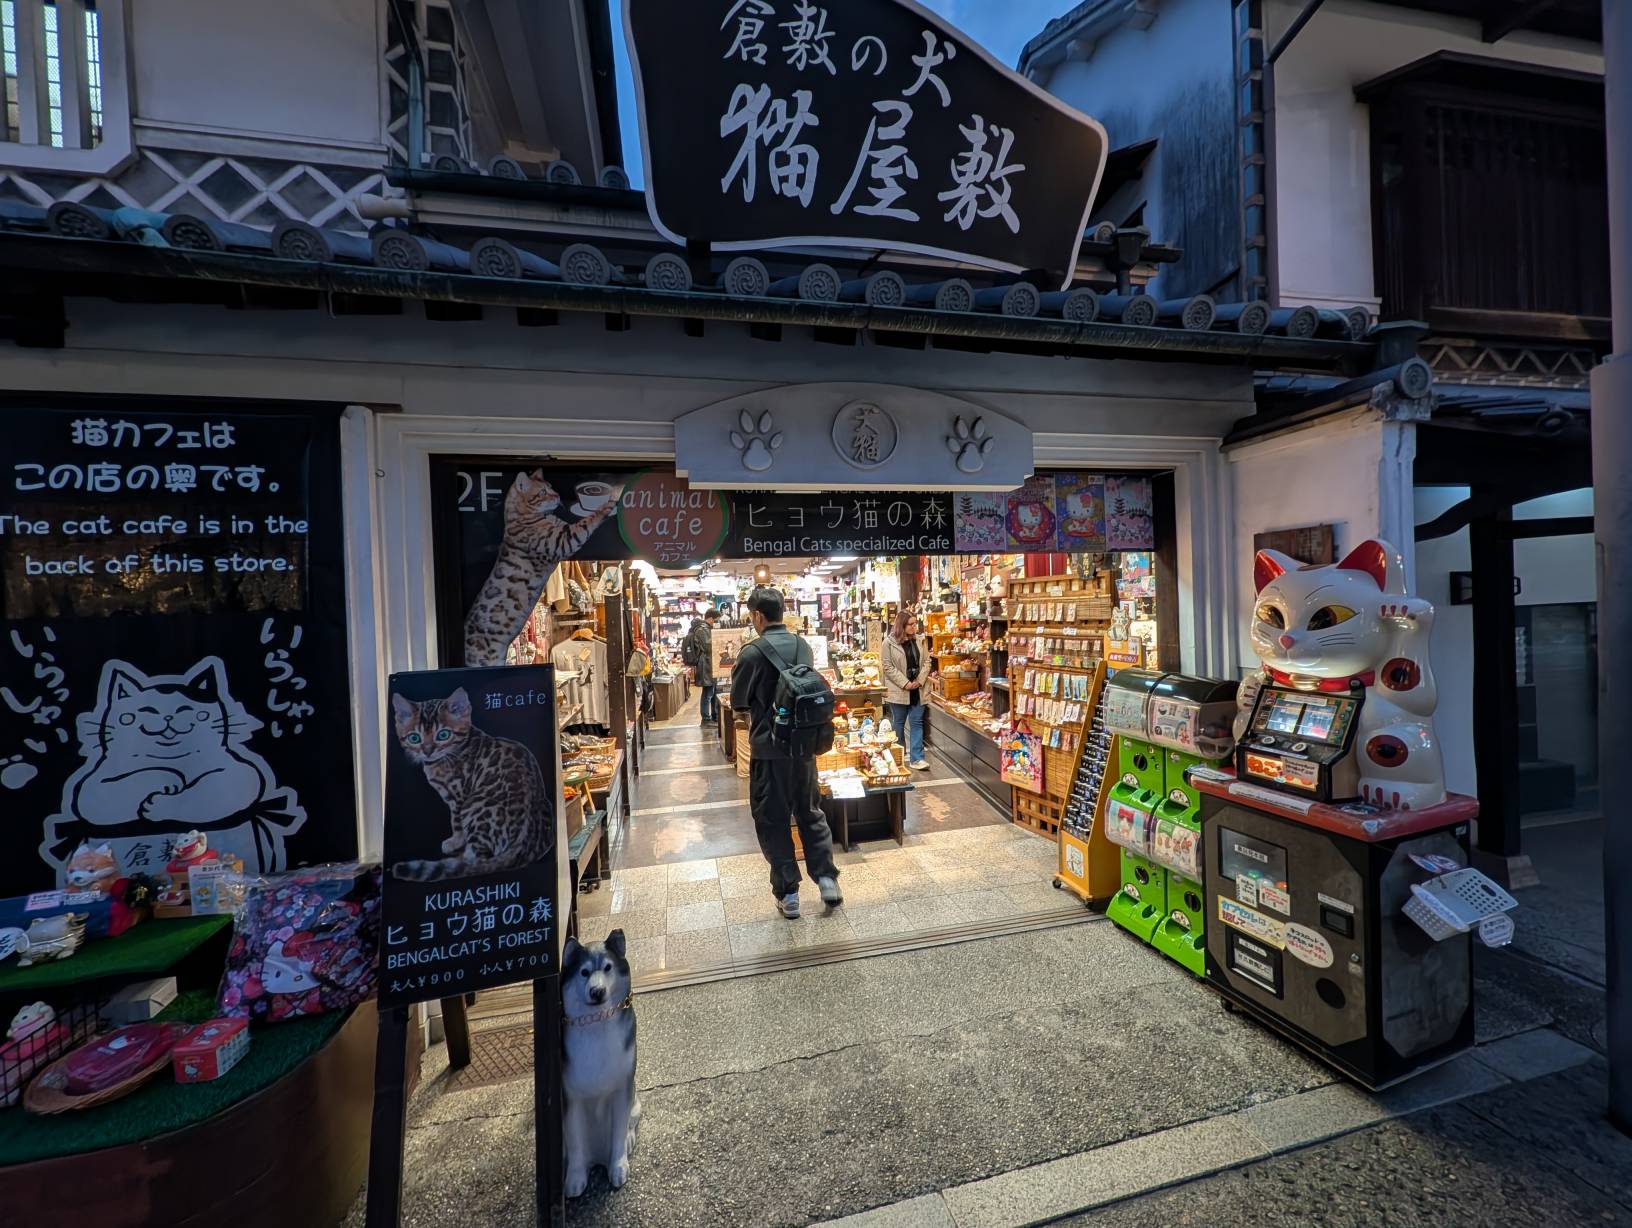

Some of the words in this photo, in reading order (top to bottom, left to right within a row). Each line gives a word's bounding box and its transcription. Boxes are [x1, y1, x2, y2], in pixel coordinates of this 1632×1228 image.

[720, 0, 956, 107] 倉敷の犬
[720, 83, 1026, 234] 猫屋敷
[71, 418, 236, 448] 猫カフェは
[14, 462, 280, 492] この店の奥です。
[456, 471, 503, 512] 2F
[622, 483, 716, 509] animal
[62, 516, 112, 535] cat
[122, 515, 188, 534] cafe
[199, 515, 220, 534] is
[231, 515, 254, 534] in
[265, 515, 309, 534] the
[639, 510, 703, 539] cafe
[749, 497, 947, 530] ヒョウ猫の森
[653, 541, 696, 552] アニマル
[659, 552, 691, 562] カフェ
[744, 536, 796, 555] Bengal
[800, 536, 833, 552] Cats
[836, 535, 915, 556] specialized
[918, 535, 950, 551] Cafe
[25, 555, 94, 575] back
[105, 554, 139, 573] of
[149, 553, 204, 573] this
[214, 553, 295, 573] store.
[260, 617, 314, 738] いらっしゃい
[485, 688, 546, 710] 猫cafe
[425, 881, 521, 912] KURASHIKI
[387, 897, 552, 946] ヒョウ猫の森
[387, 937, 491, 970] BENGALCAT'S
[498, 927, 550, 949] FOREST
